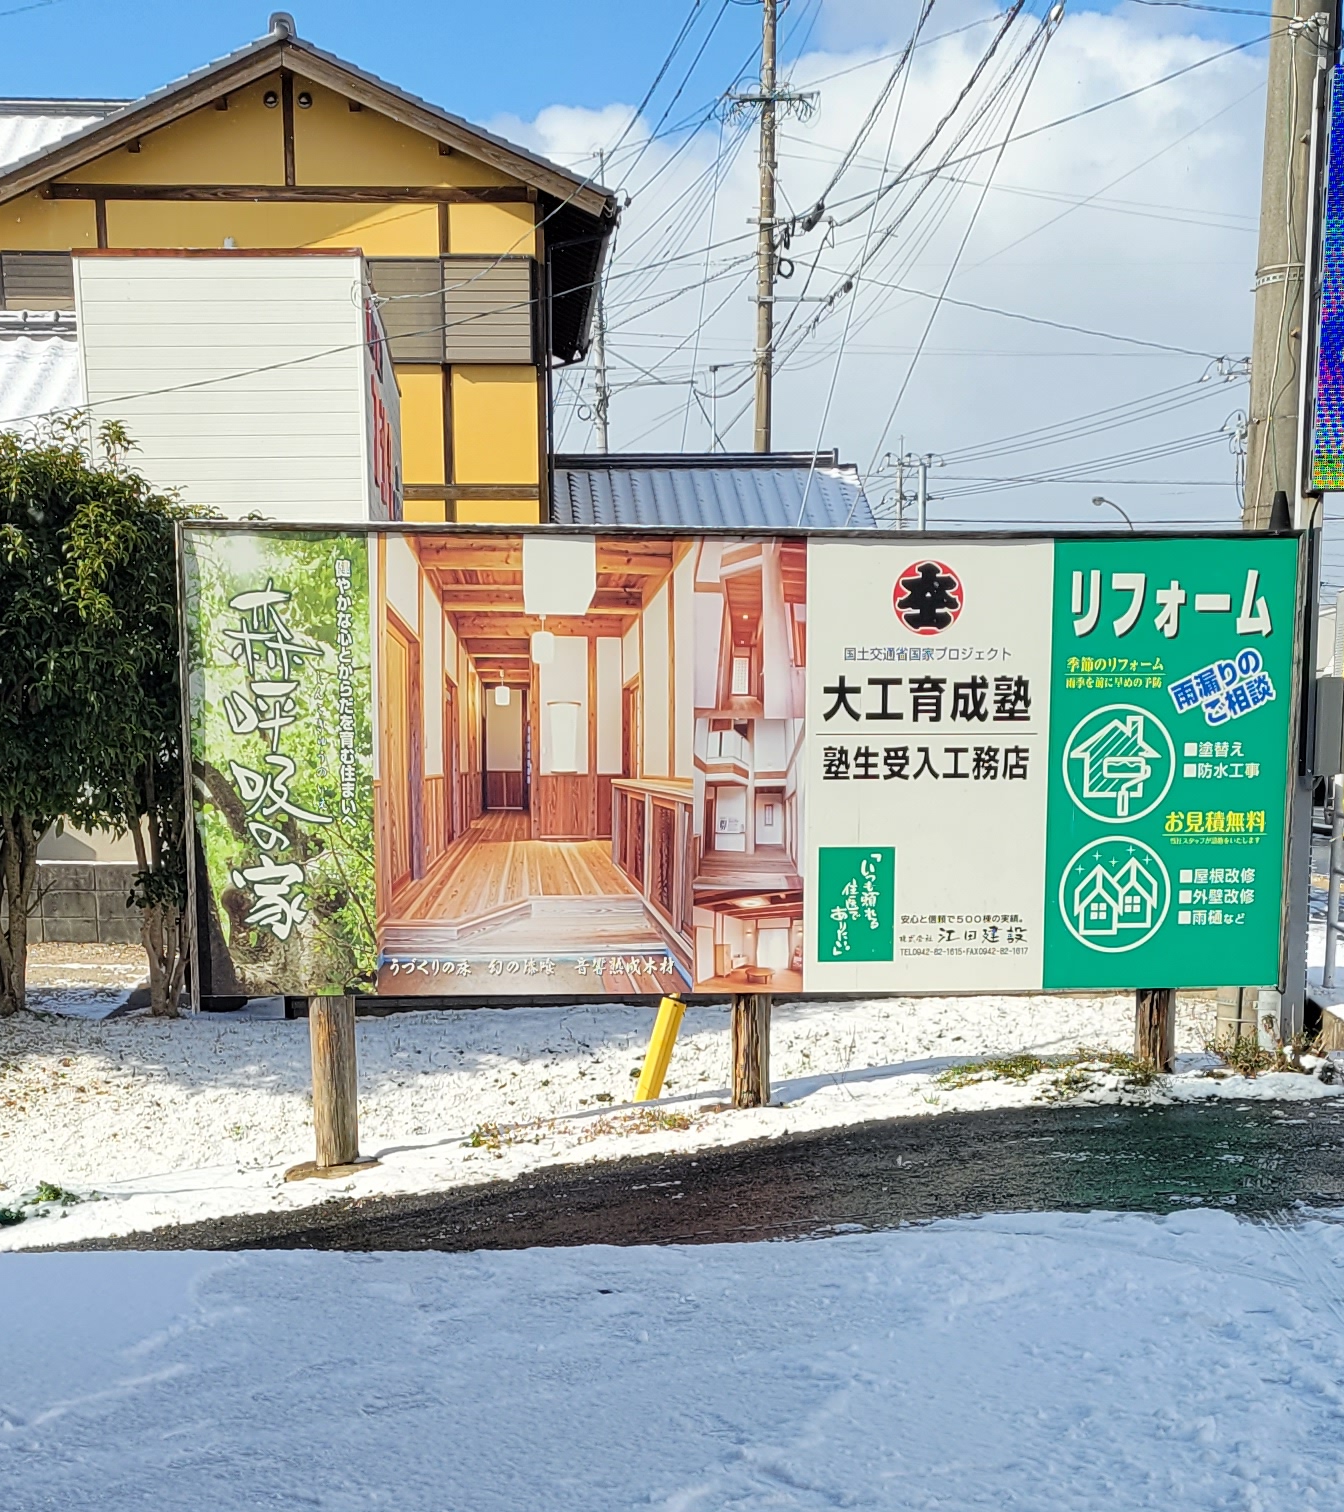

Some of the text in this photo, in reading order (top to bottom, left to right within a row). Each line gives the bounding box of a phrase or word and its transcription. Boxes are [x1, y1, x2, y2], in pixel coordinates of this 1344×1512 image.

[1071, 569, 1273, 639] リフォーム
[844, 646, 1012, 662] 国土交通省国家プロジェクト
[1066, 656, 1164, 673] 季節のリフォーム
[335, 559, 356, 826] 健やかな心とからだを育む住まいへ
[822, 675, 1032, 722] 大工育成塾
[1170, 649, 1262, 711] 雨漏りの
[1203, 674, 1275, 725] ご相談
[222, 579, 333, 941] 森呼吸の家
[822, 745, 1031, 781] 塾生受入工務店
[1164, 810, 1266, 833] お見積無料
